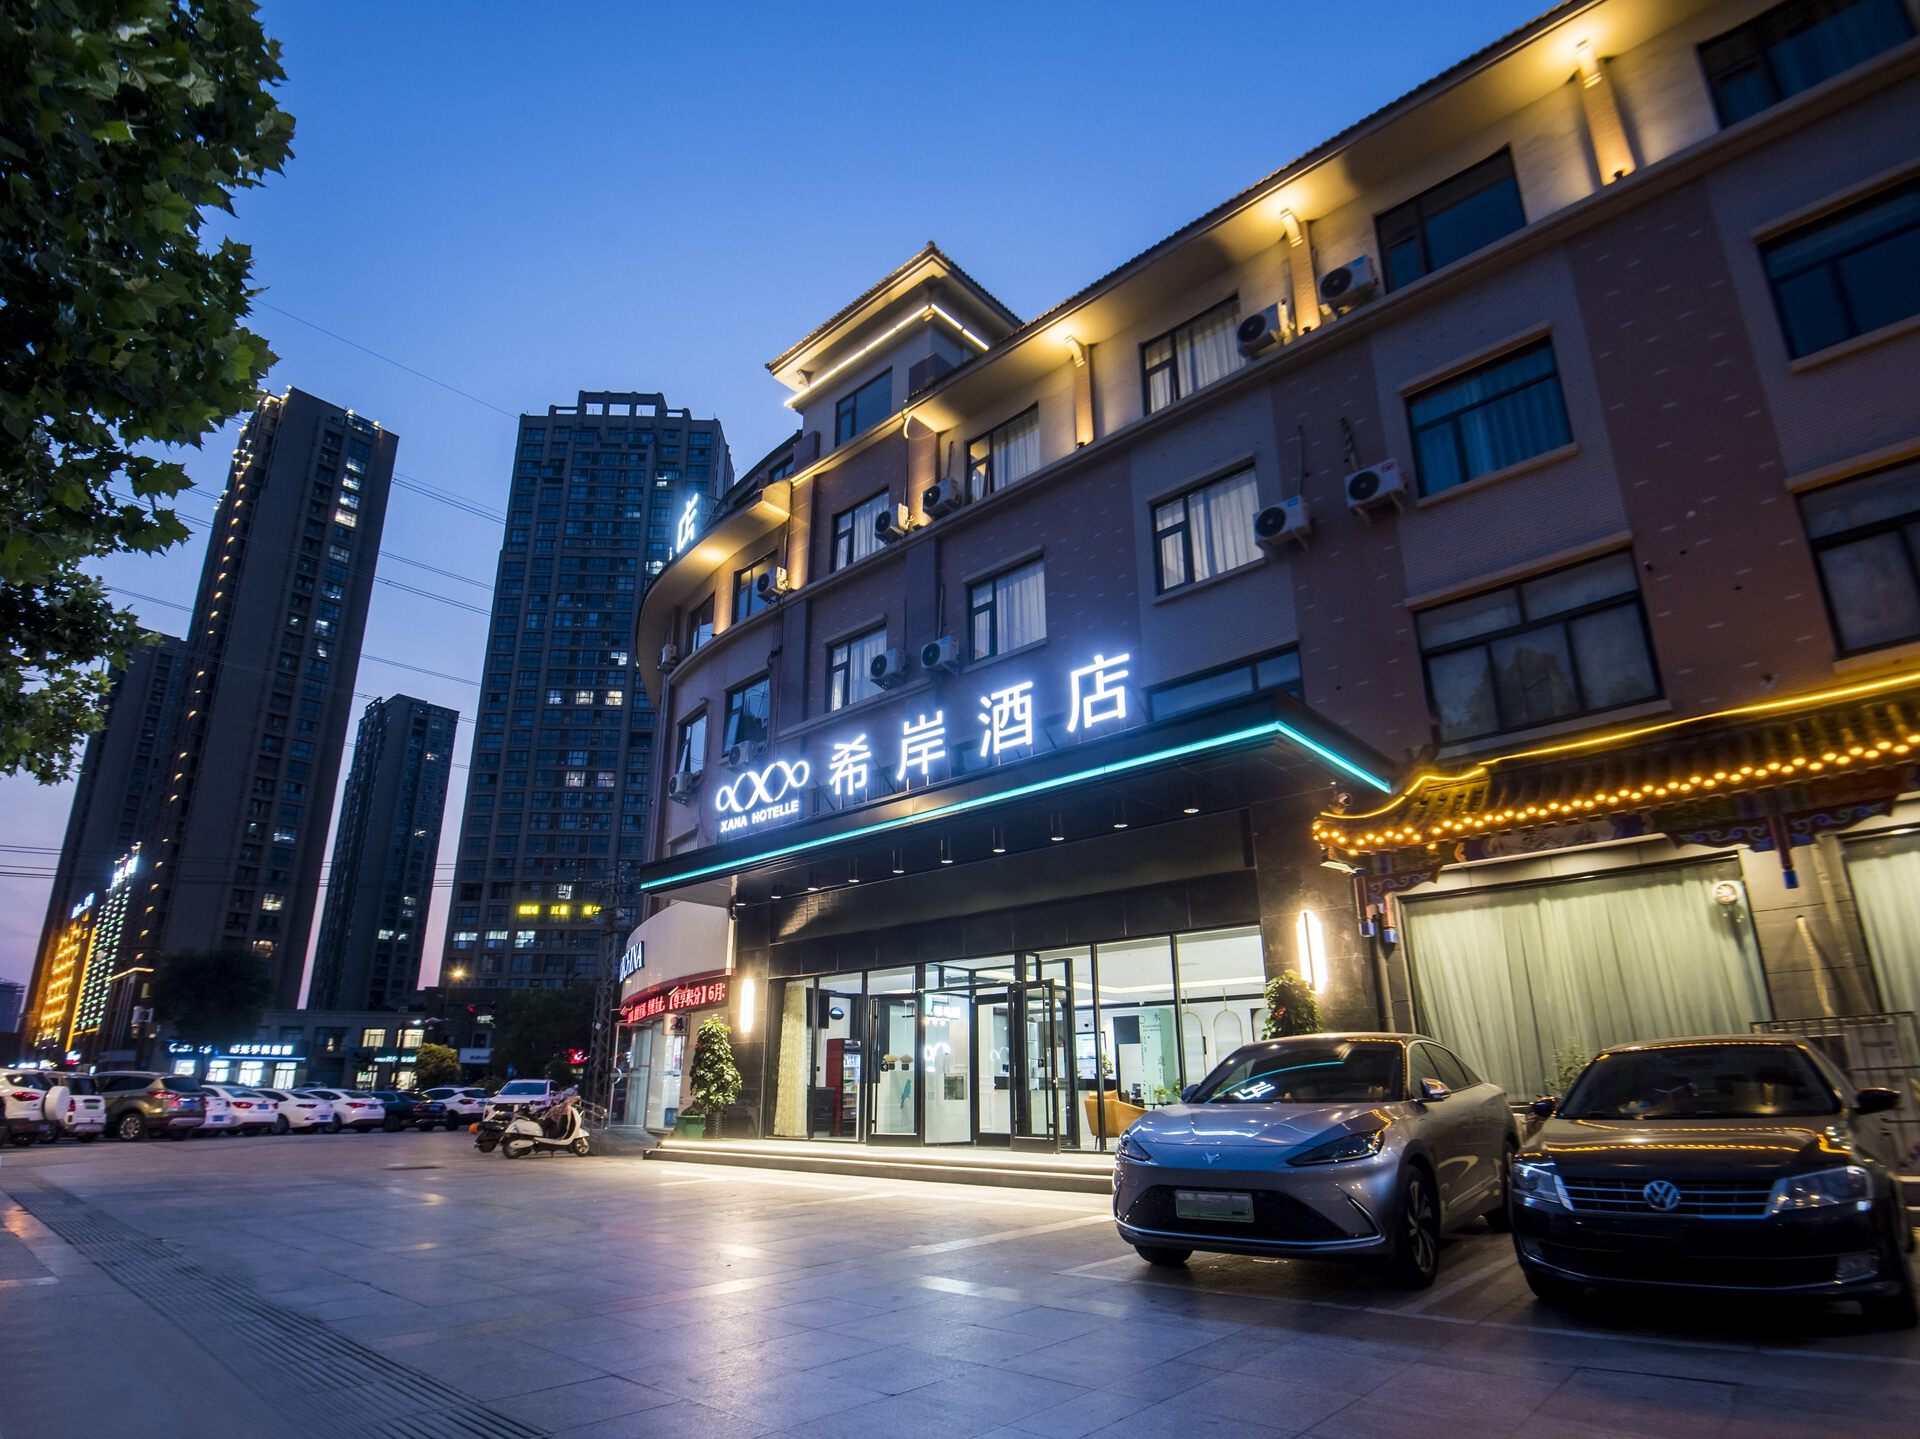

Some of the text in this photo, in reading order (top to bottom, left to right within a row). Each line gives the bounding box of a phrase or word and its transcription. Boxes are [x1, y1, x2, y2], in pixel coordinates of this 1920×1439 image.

[828, 652, 1131, 797] 希岸酒店
[720, 800, 800, 833] XANA HOTELLE
